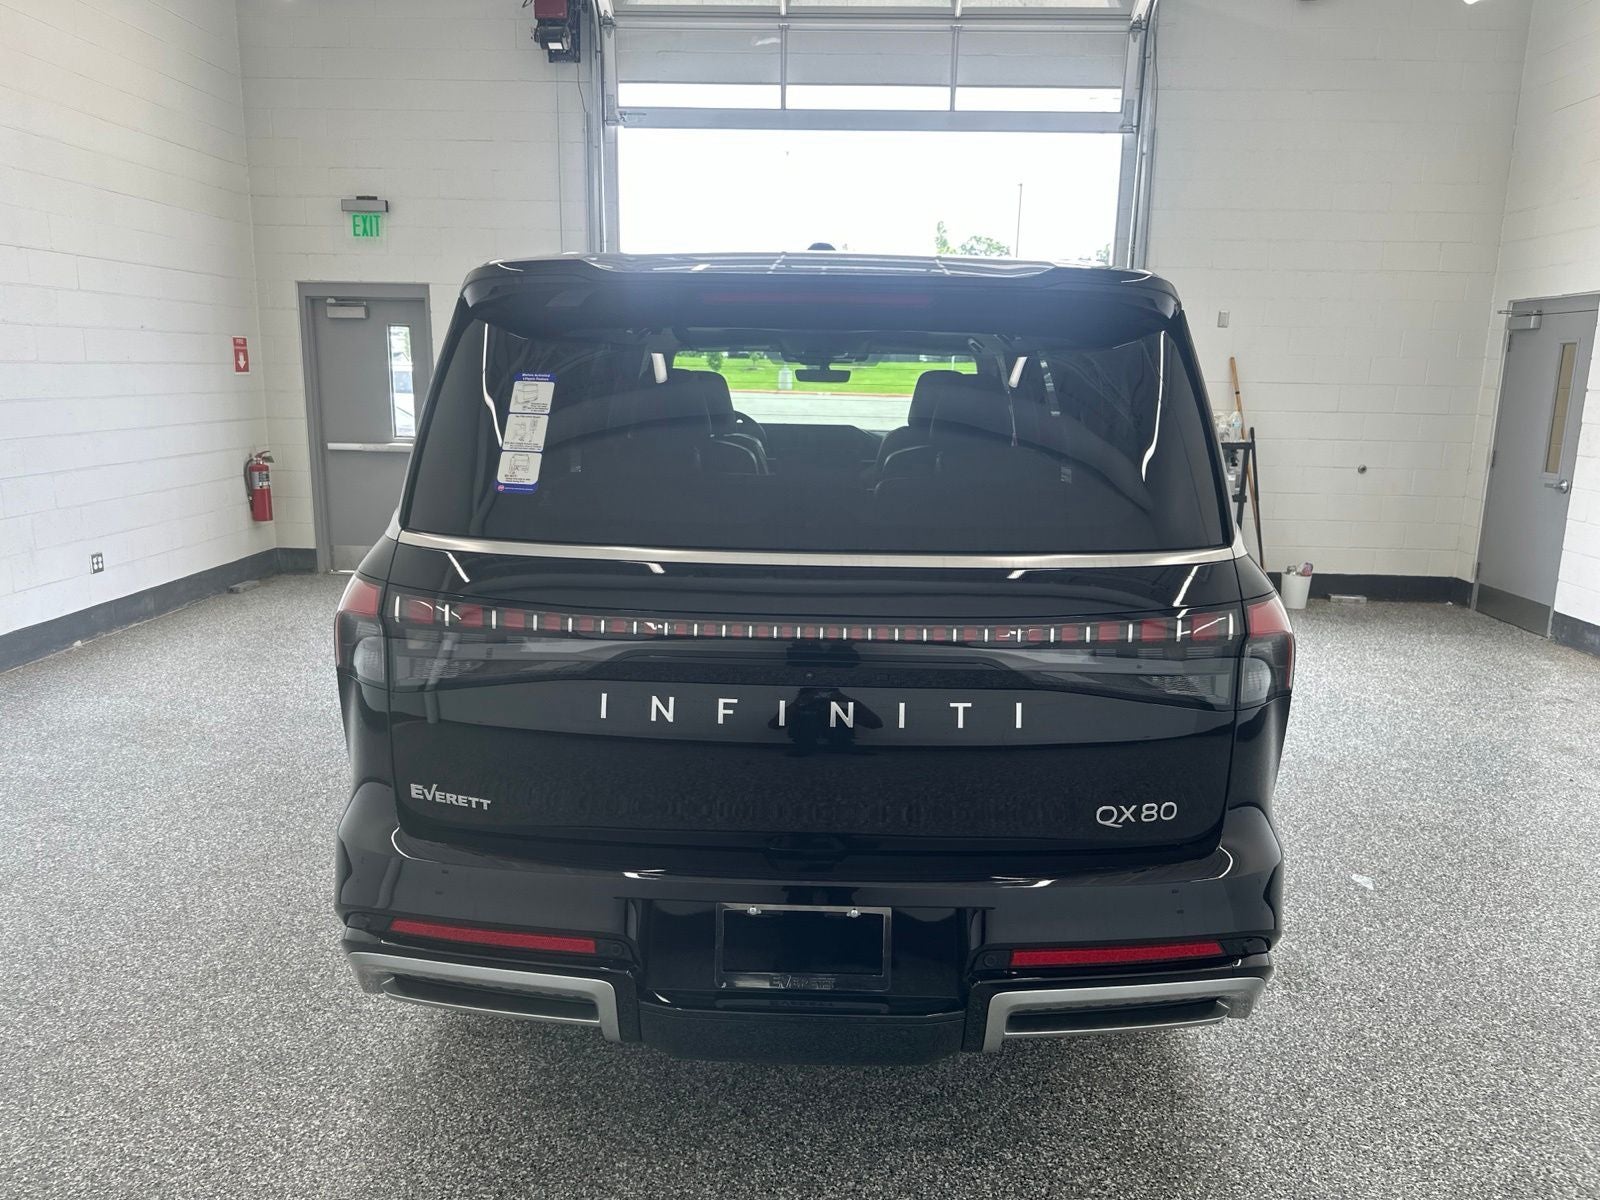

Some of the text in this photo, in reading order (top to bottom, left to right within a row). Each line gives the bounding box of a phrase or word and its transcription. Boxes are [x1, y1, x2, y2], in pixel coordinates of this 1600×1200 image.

[352, 214, 381, 237] EXIT
[600, 693, 1022, 729] INFINITI
[410, 783, 491, 810] EVERETT
[1096, 801, 1178, 828] QX80
